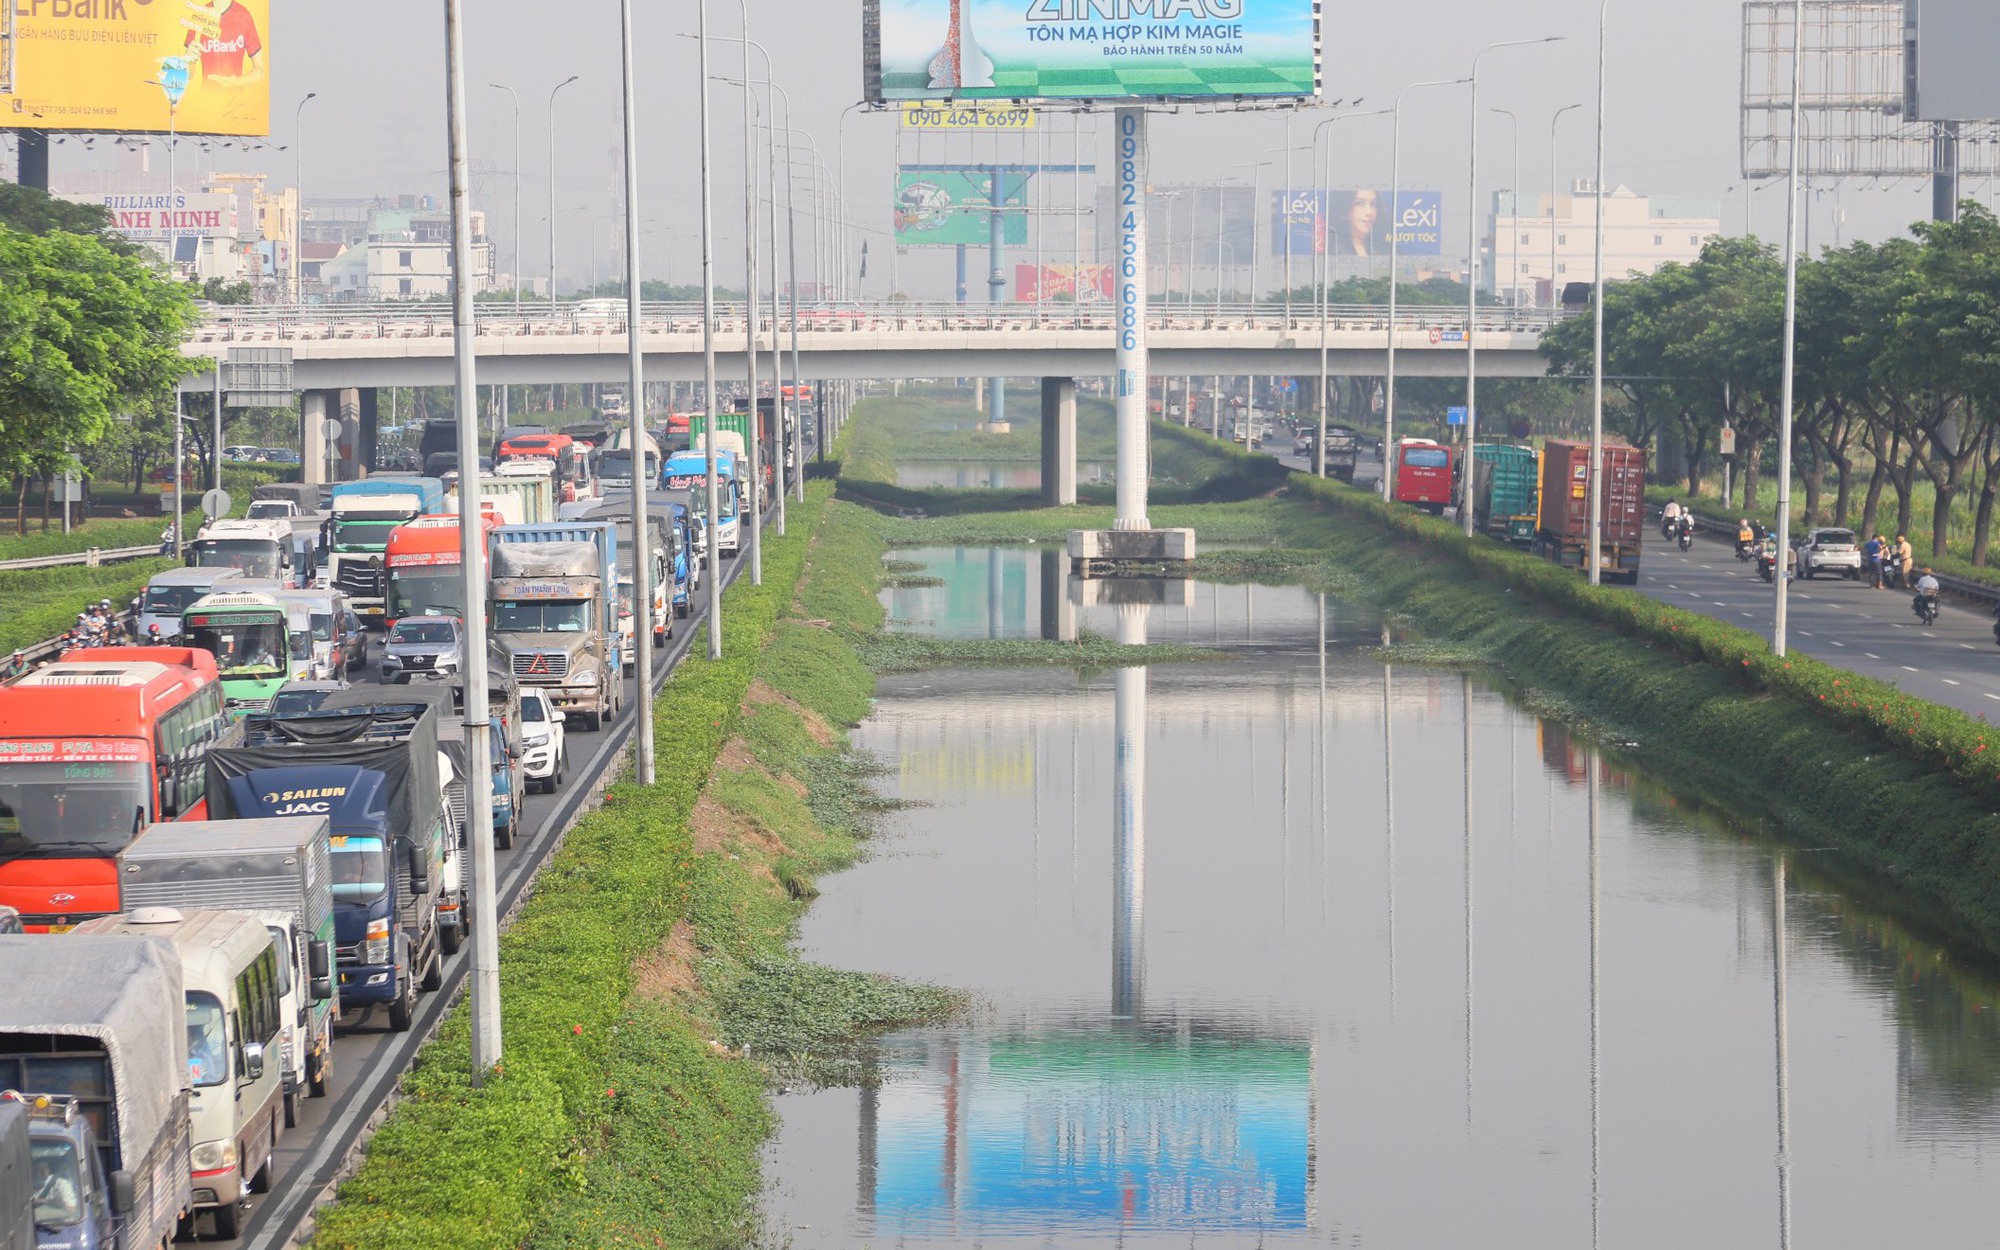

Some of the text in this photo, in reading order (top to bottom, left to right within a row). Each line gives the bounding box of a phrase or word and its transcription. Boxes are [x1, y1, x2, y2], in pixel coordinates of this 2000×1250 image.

[1026, 24, 1243, 44] TÔN MẠ HỢP KIM MAGIE
[1130, 44, 1165, 55] HÀNH
[1167, 44, 1197, 55] TRÊN
[1200, 46, 1213, 55] 50
[1216, 43, 1243, 55] NĂM
[909, 110, 1029, 126] 090 464 6699
[1282, 192, 1319, 214] Léxi
[160, 211, 221, 228] MINH
[553, 586, 570, 594] LONG
[282, 787, 346, 801] SAILUN
[275, 801, 330, 815] JAC
